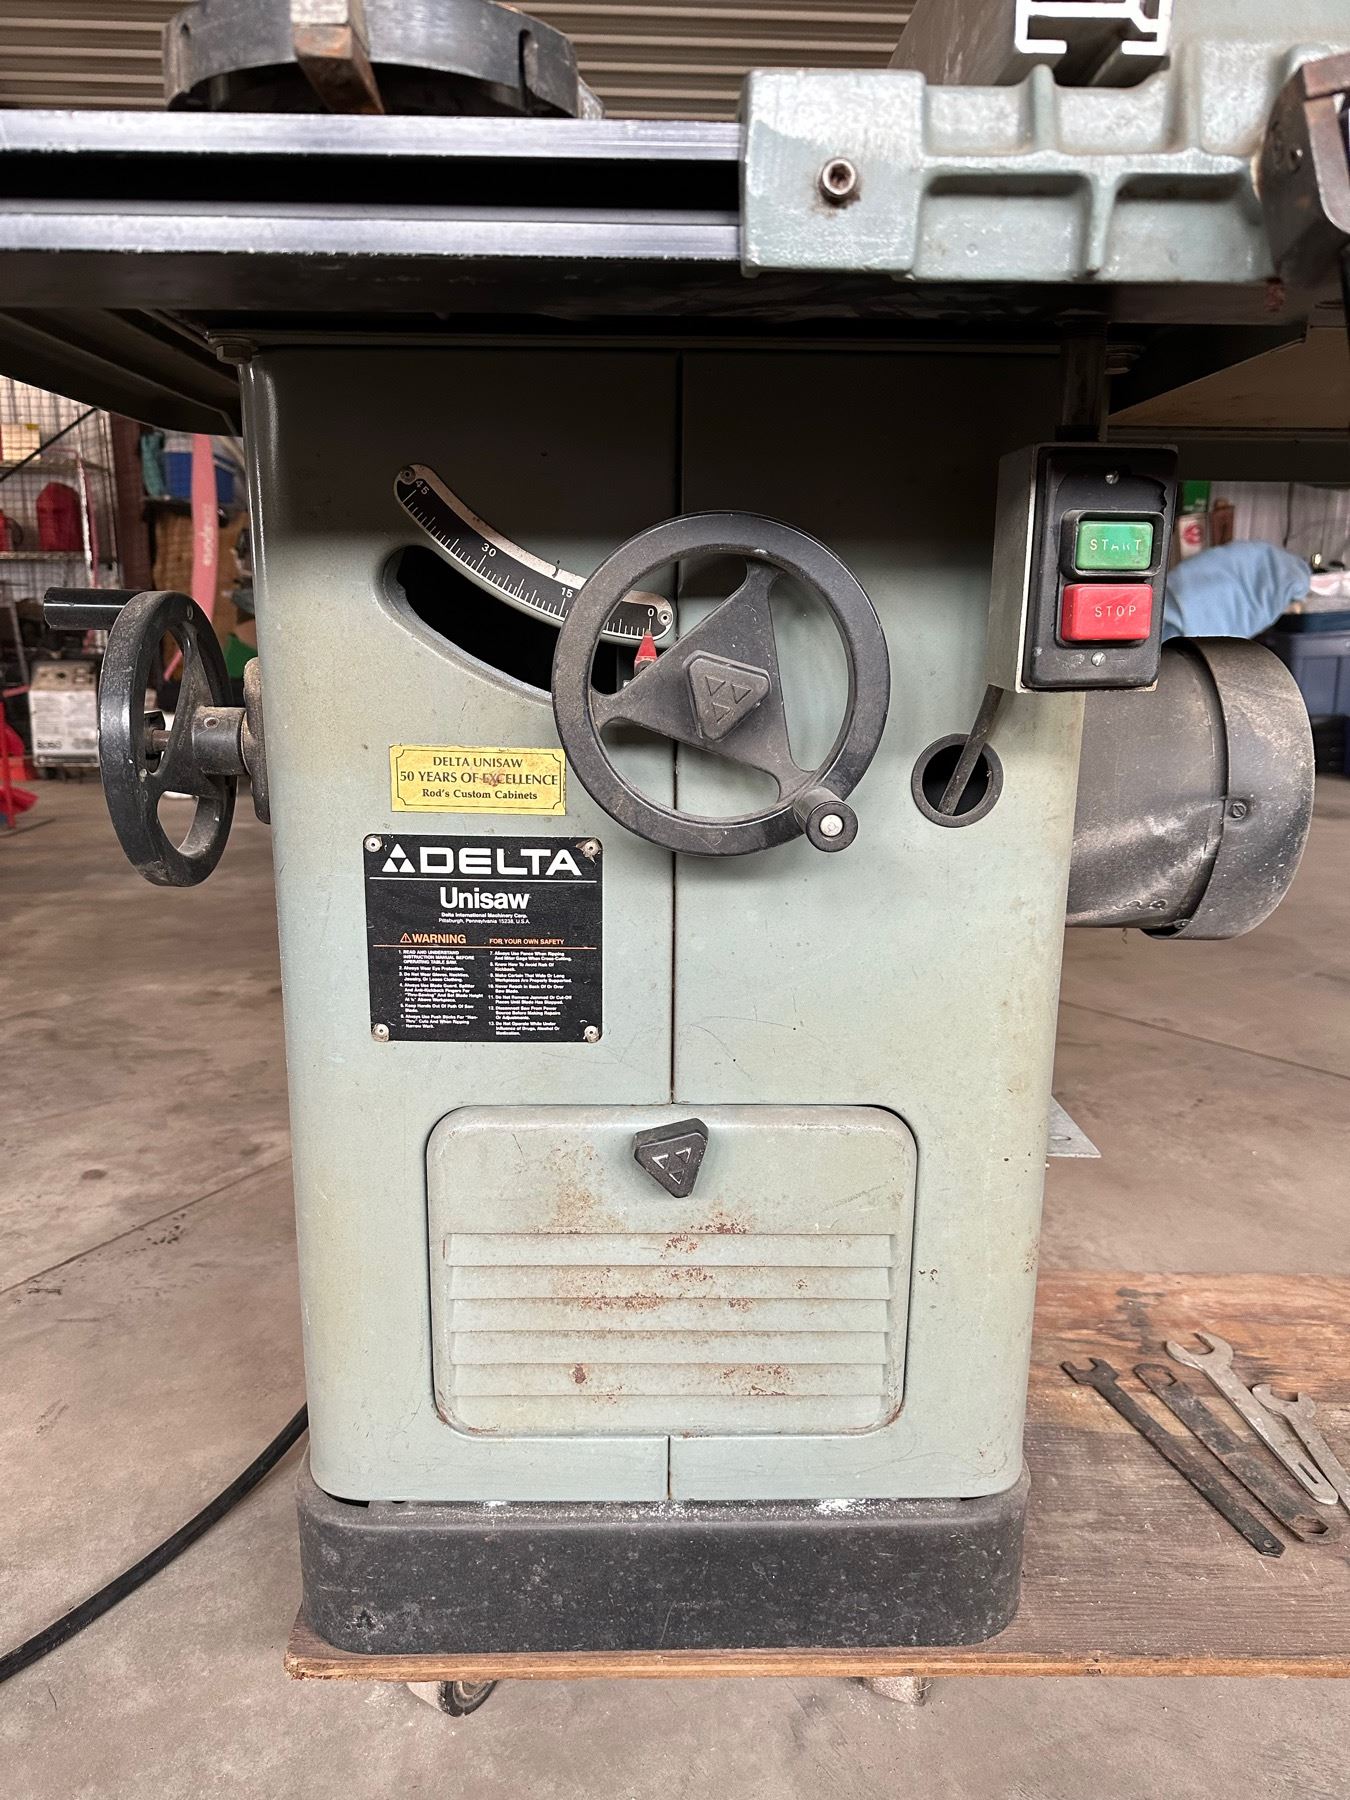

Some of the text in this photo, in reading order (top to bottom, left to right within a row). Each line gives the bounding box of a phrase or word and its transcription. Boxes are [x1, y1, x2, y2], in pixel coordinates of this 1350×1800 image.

[415, 480, 430, 495] 45
[481, 543, 496, 557] 30
[561, 587, 573, 598] 15
[648, 608, 654, 617] 0
[1094, 605, 1137, 617] STOP
[433, 757, 523, 768] DELTA UNISAW
[400, 771, 558, 785] 50 YEARS OF EXCELLENCE
[422, 789, 537, 799] Rod's Custom Cabinets
[420, 847, 582, 876] DELTA
[440, 887, 530, 909] Unisaw
[412, 934, 466, 943] WARNING
